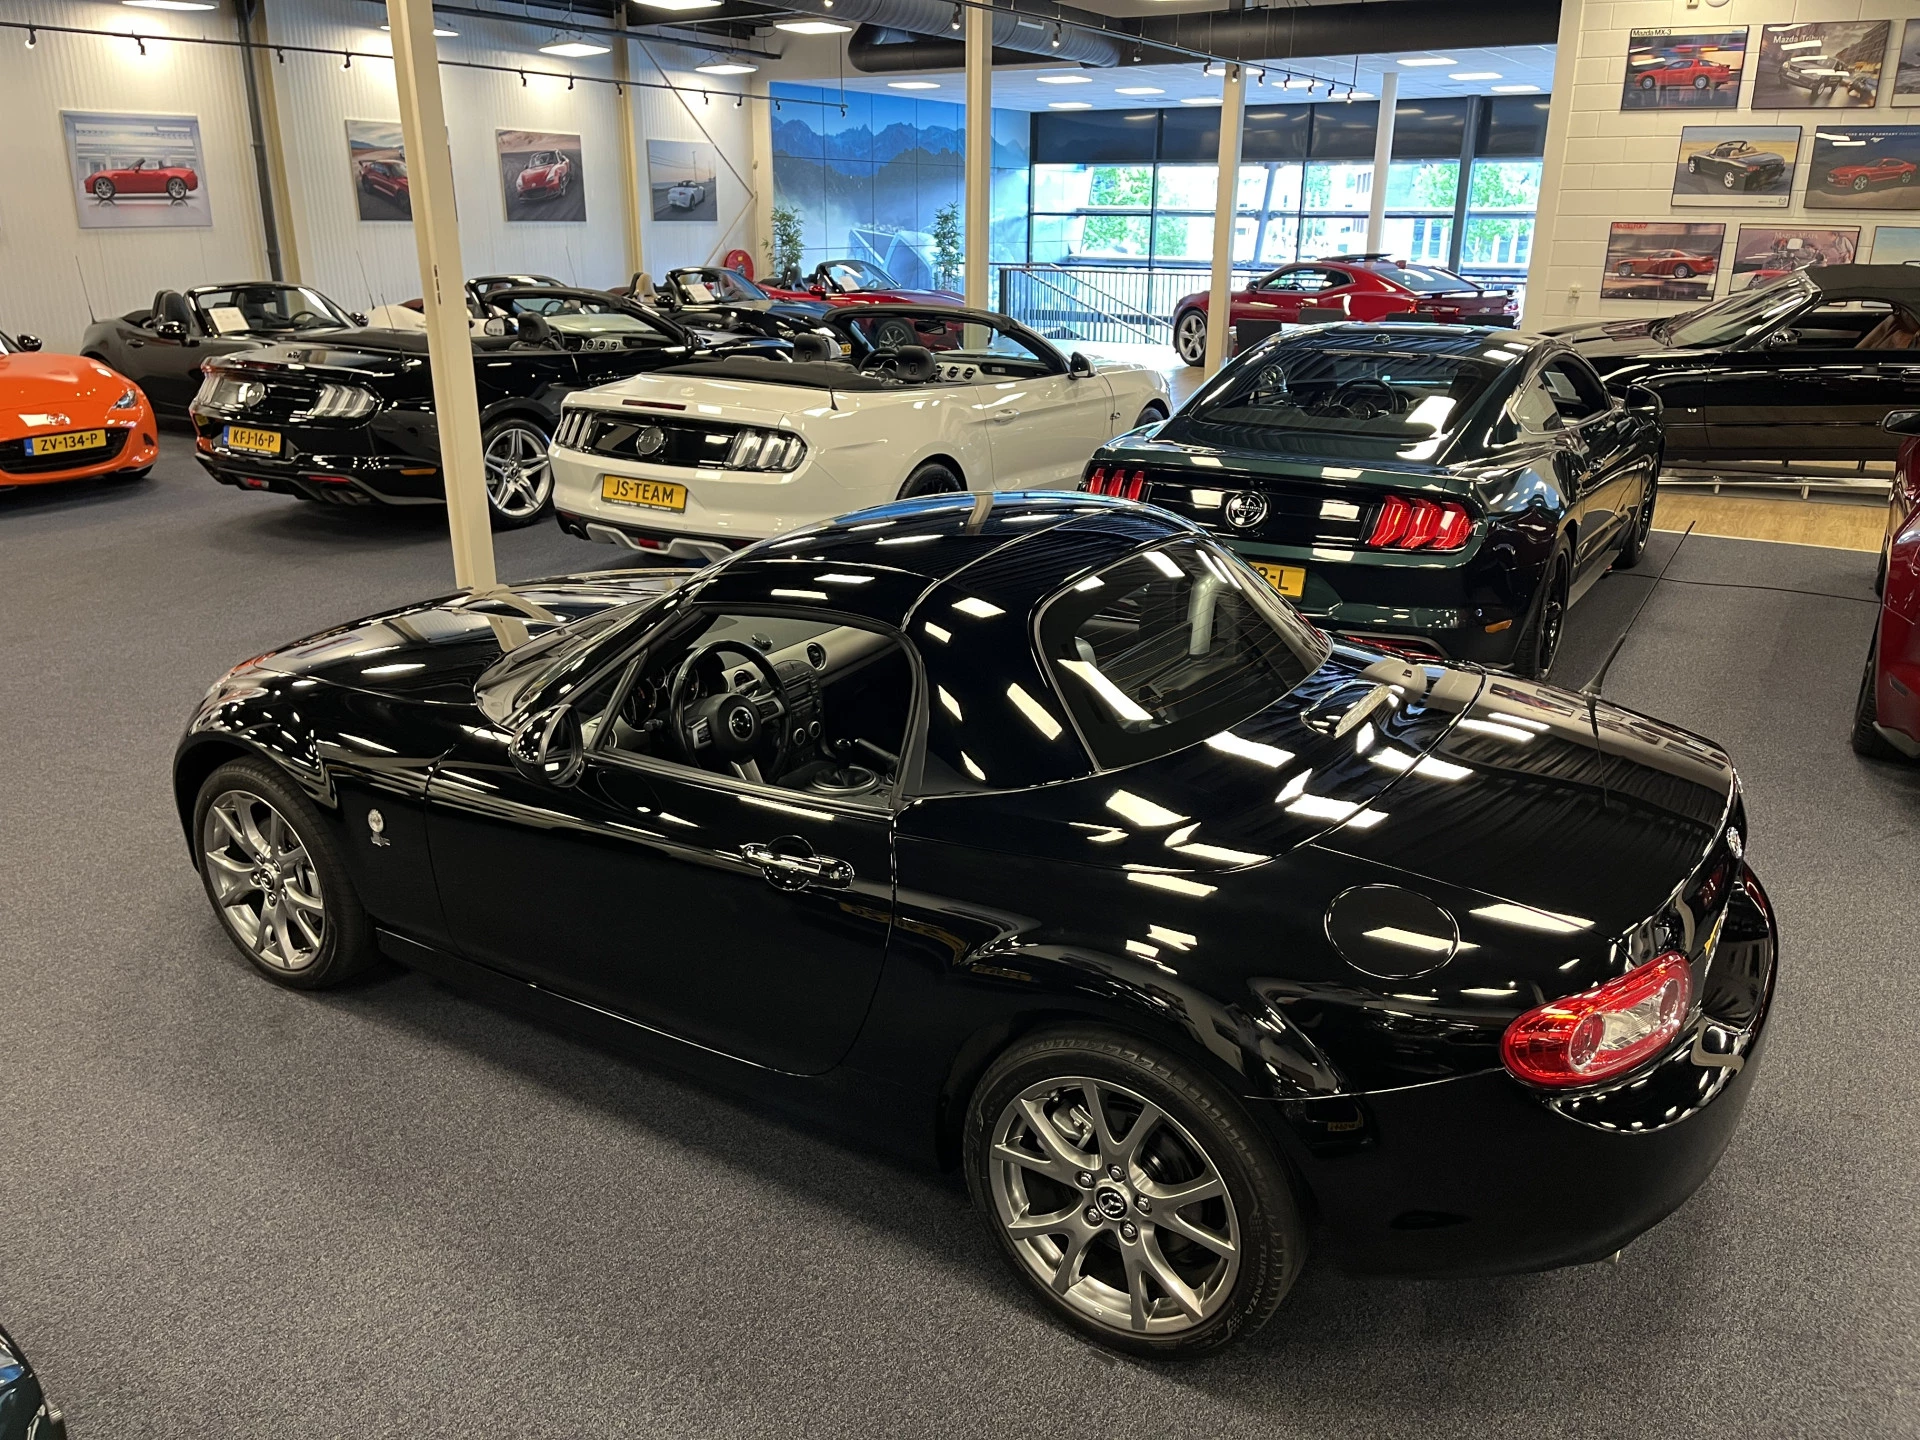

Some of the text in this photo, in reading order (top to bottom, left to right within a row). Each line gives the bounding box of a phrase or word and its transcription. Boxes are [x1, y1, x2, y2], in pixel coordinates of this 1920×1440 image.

[1632, 27, 1672, 36] Mazda MX-3
[1773, 35, 1799, 44] Mazda
[41, 433, 97, 451] ZV-134-P
[233, 429, 275, 448] KFJ-16-P
[613, 480, 674, 503] JS-TEAM
[1244, 1242, 1268, 1315] TURANZA
